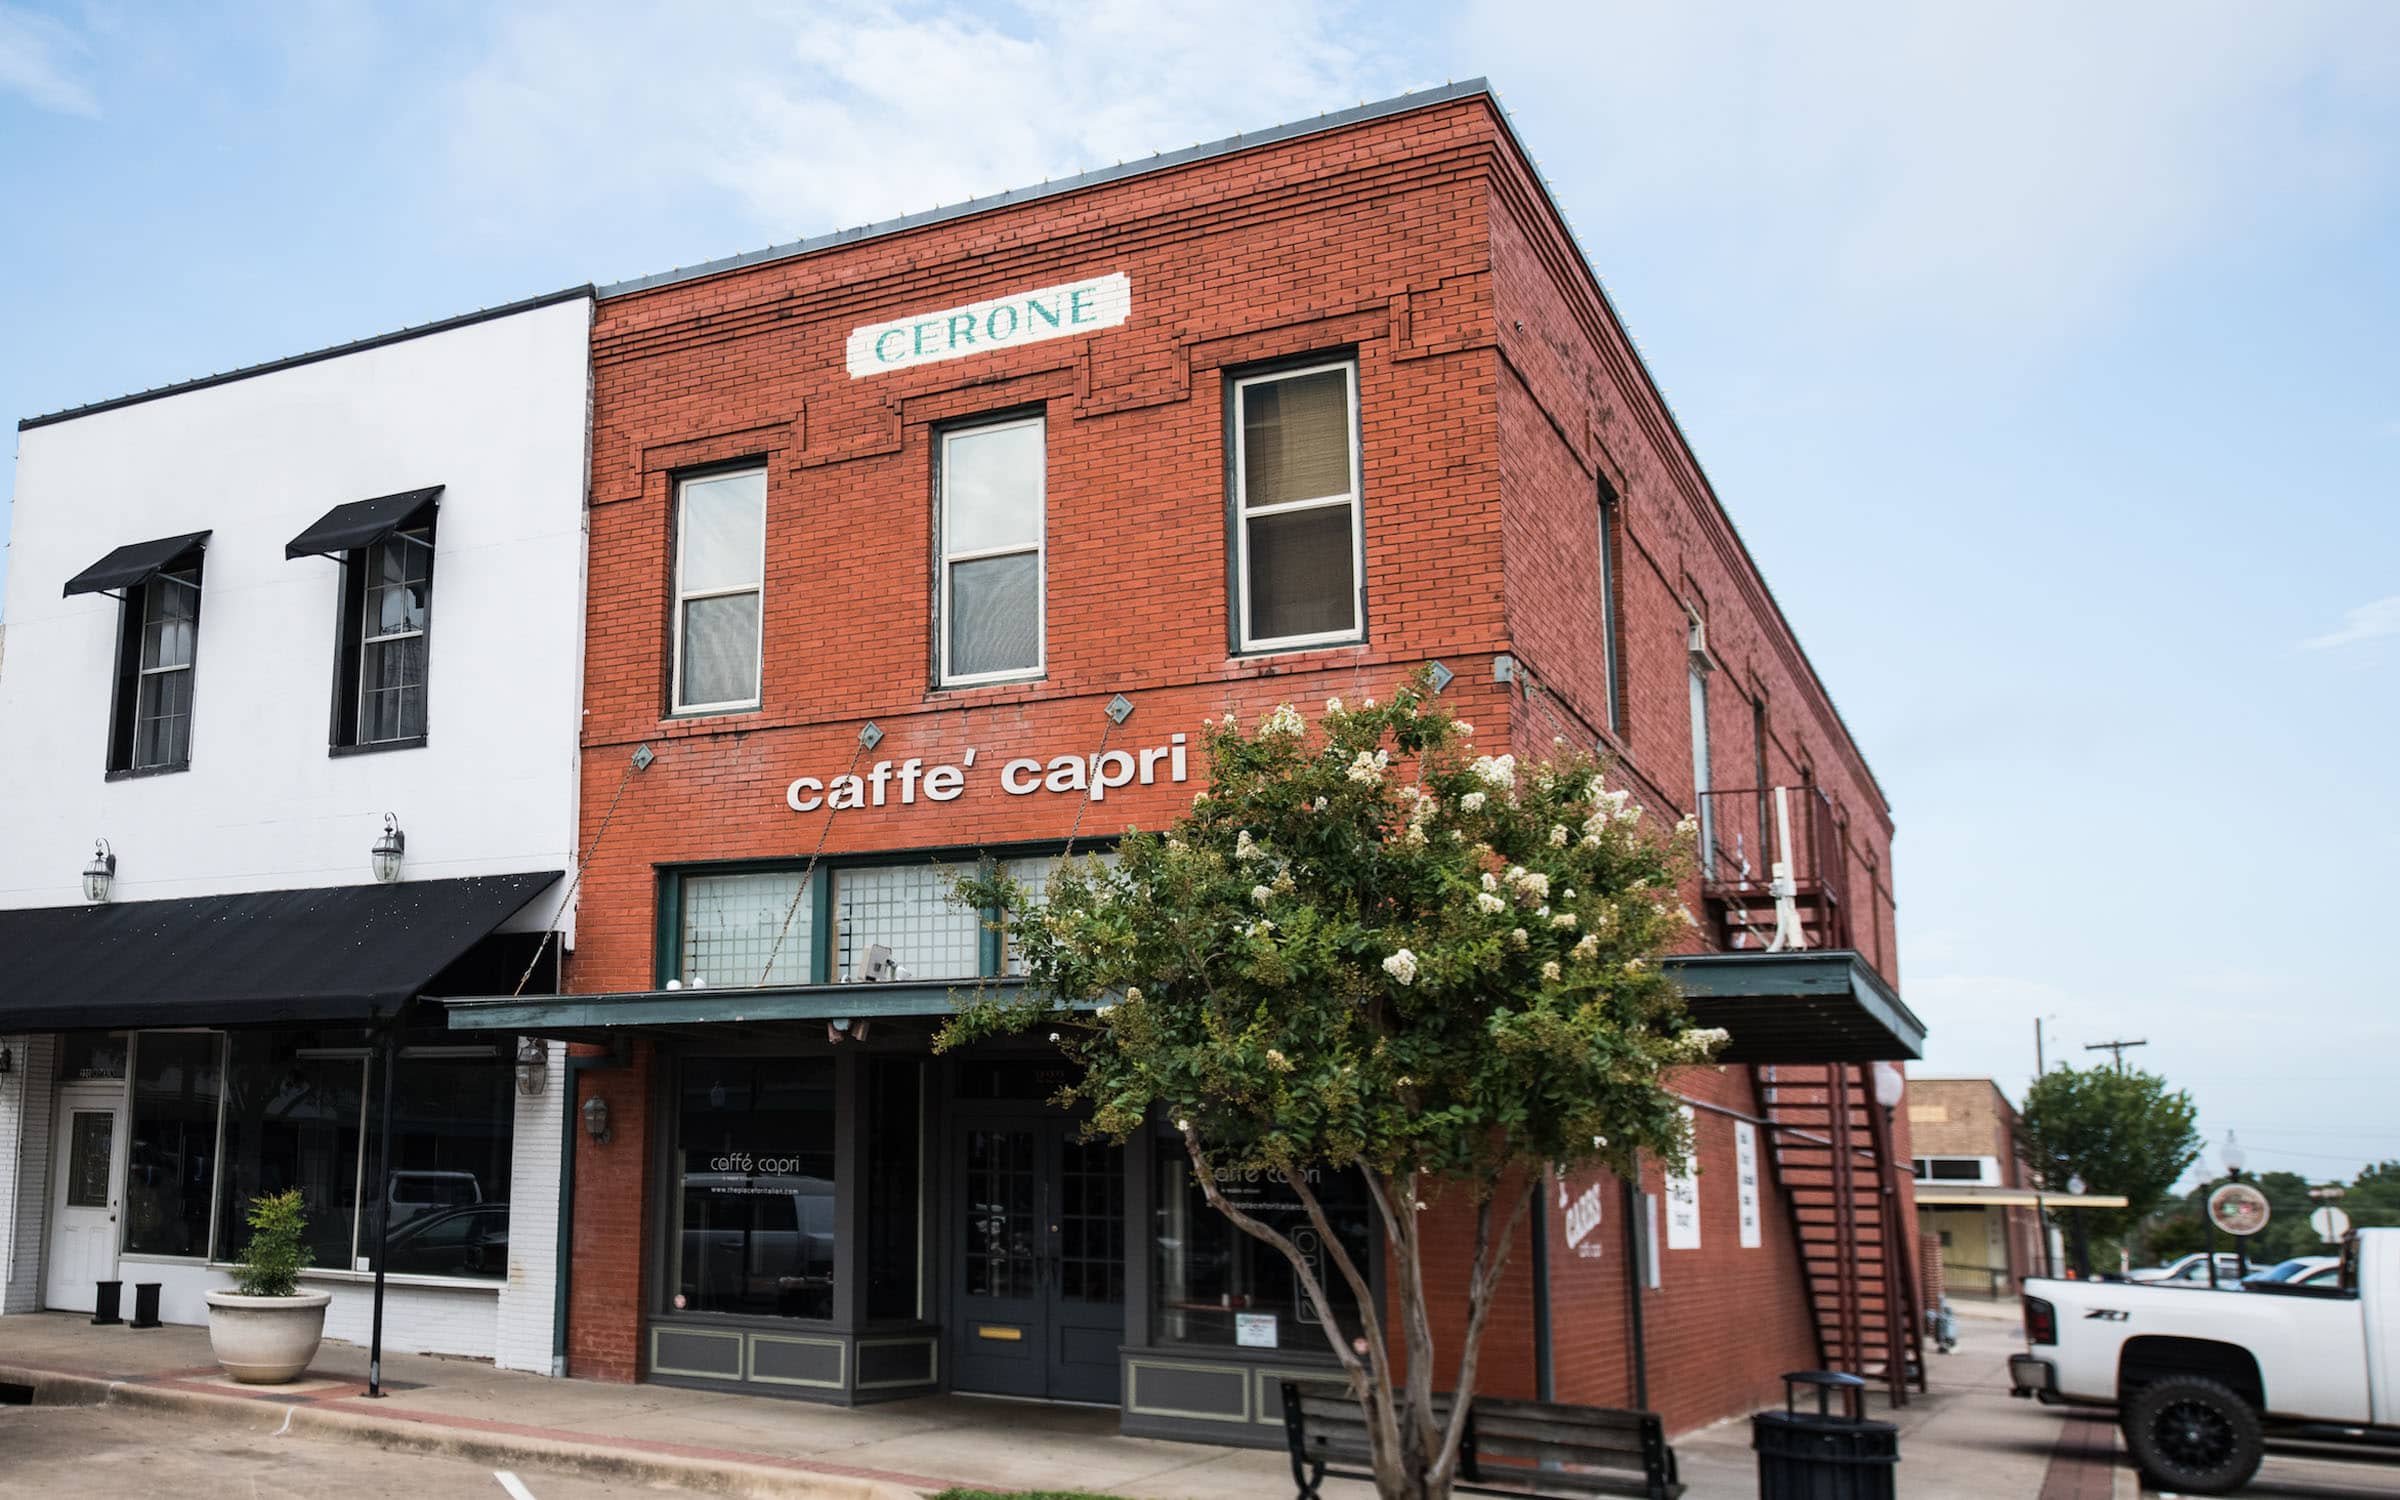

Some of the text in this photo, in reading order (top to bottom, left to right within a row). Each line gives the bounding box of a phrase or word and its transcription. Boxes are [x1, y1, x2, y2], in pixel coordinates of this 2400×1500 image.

[875, 287, 1097, 363] CERONE
[1000, 733, 1187, 801] capri
[710, 1152, 800, 1177] caffé capri
